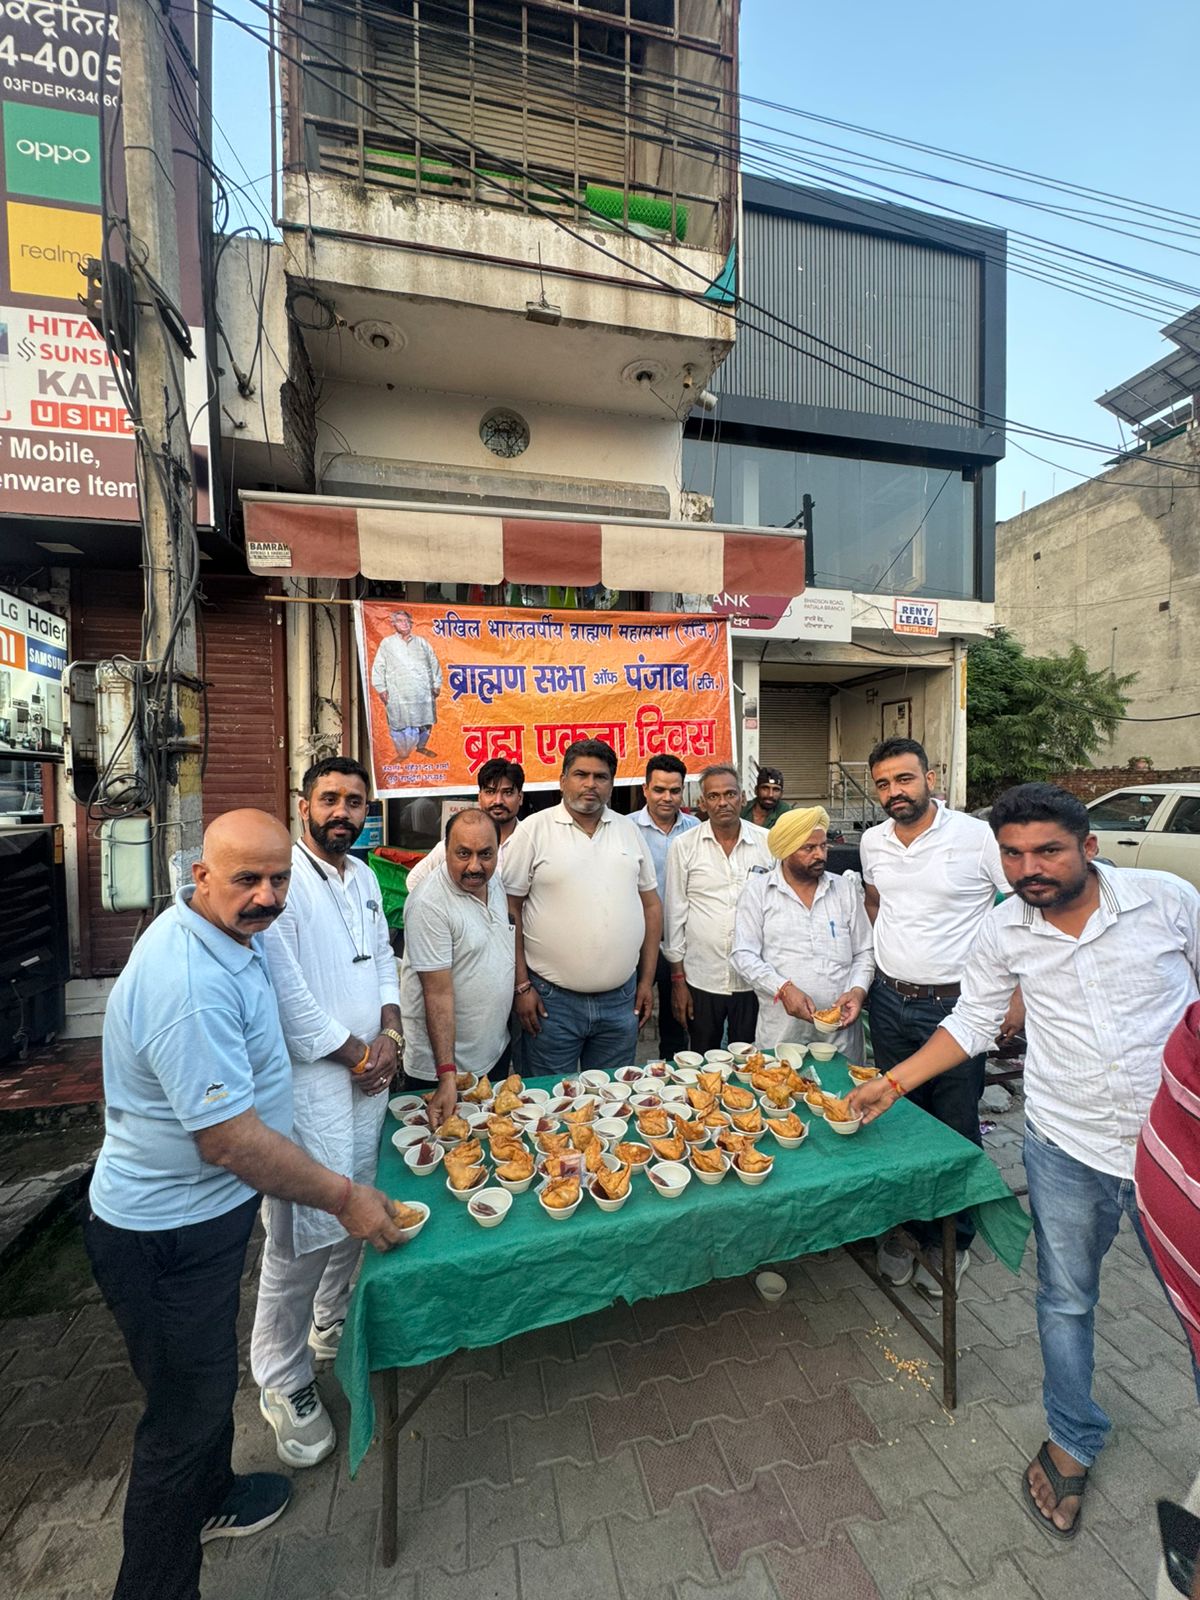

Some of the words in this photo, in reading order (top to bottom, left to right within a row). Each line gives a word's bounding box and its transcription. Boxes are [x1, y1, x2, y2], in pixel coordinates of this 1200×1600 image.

[28, 314, 106, 341] HITA
[9, 436, 101, 469] Mobile,
[0, 472, 81, 495] nware
[0, 598, 18, 621] LG
[27, 608, 66, 642] Haier
[432, 611, 480, 638] अखिल
[487, 614, 564, 640] भारतवर्षीय
[618, 624, 671, 643] महासभा
[899, 615, 934, 626] LEASE
[901, 606, 934, 617] RENT/
[532, 665, 586, 693] सभा
[593, 668, 618, 684] ऑफ
[623, 653, 690, 691] पंजाब
[635, 704, 717, 757] दिवस
